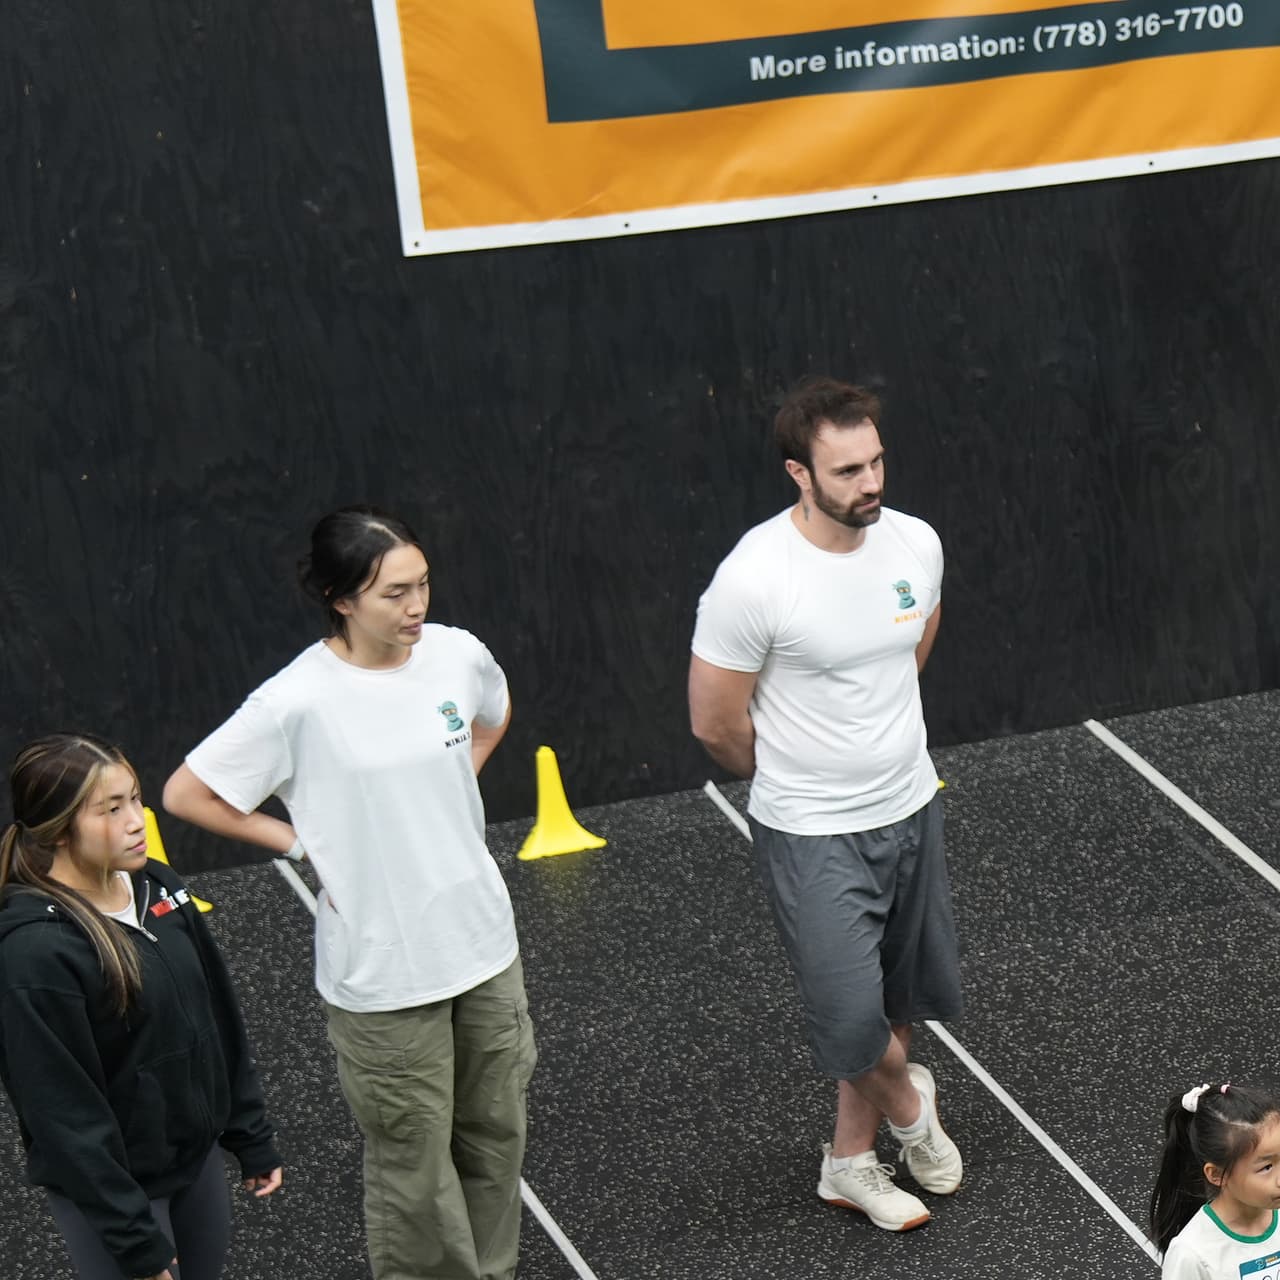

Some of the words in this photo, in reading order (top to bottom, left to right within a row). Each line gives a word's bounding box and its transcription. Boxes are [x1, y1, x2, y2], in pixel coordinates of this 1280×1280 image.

[750, 53, 827, 81] More
[835, 35, 1025, 70] information:
[1033, 19, 1107, 52] (778)
[1115, 3, 1244, 42] 316-7700
